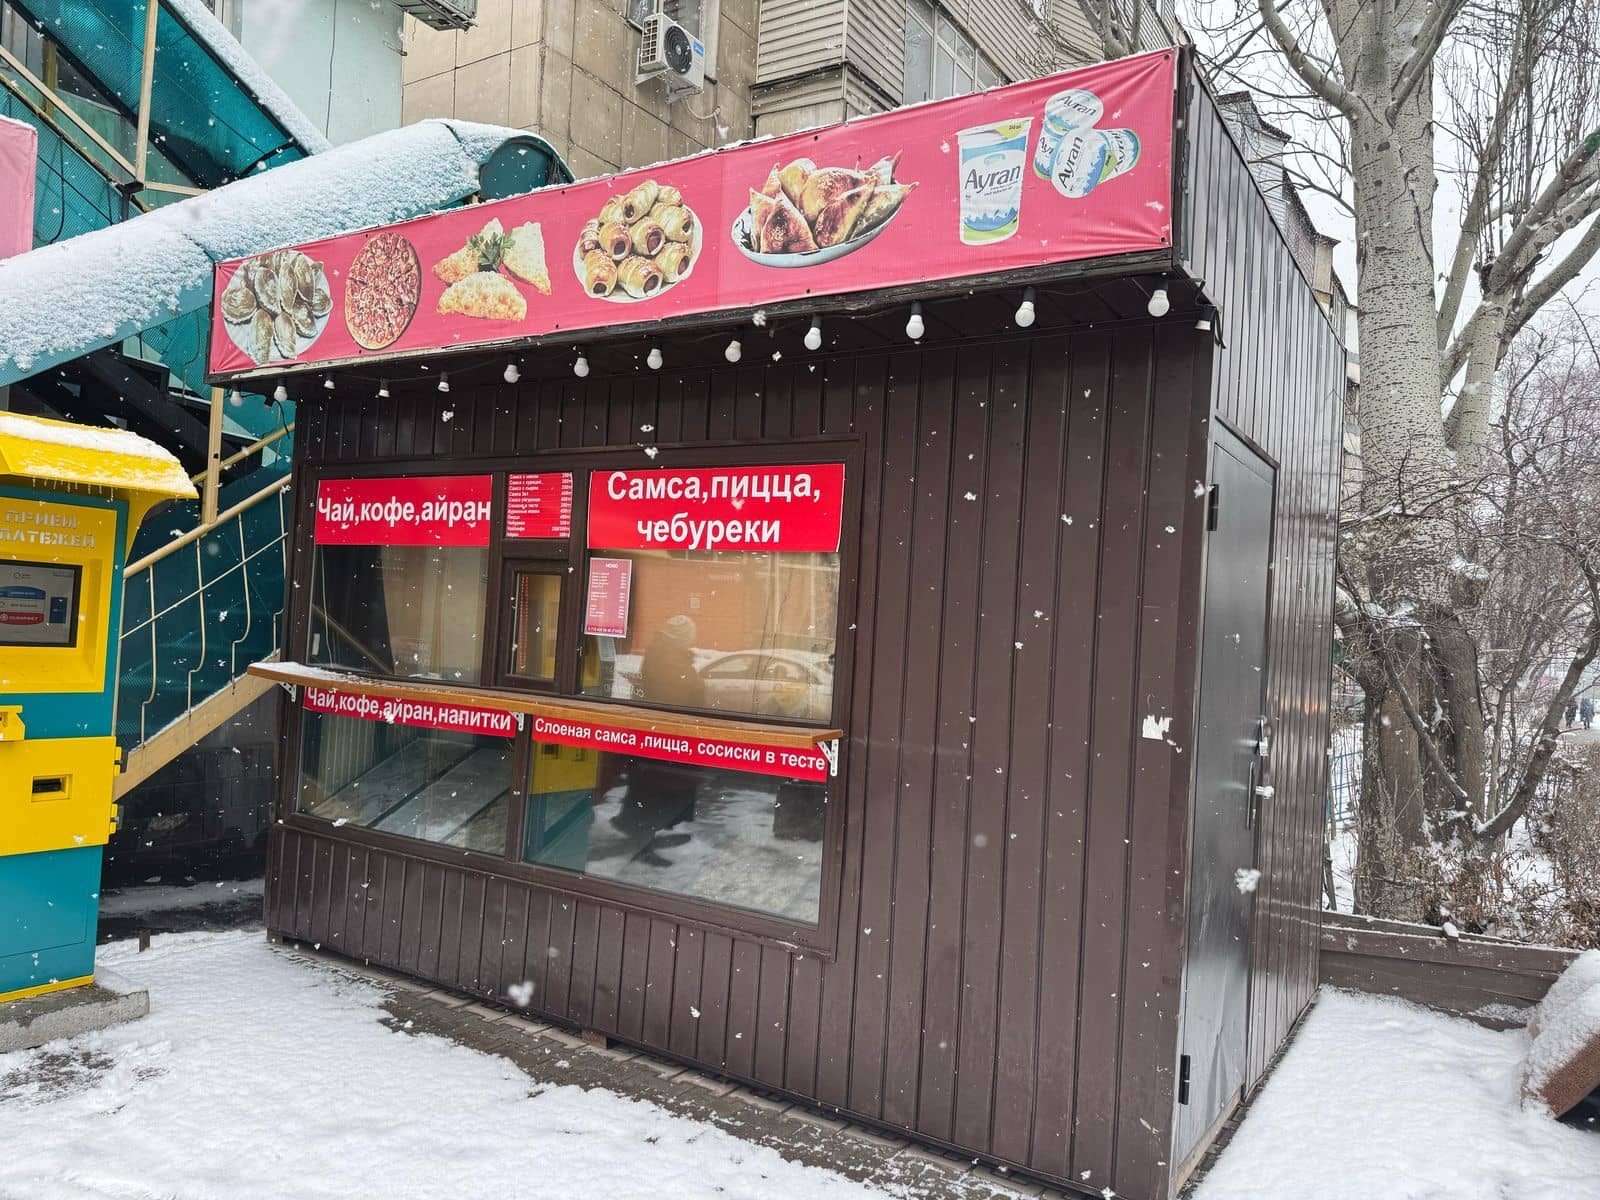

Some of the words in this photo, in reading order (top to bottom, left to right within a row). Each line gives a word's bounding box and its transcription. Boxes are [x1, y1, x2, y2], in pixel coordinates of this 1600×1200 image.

[1057, 96, 1097, 116] Ayran
[964, 165, 1021, 194] Ayran
[1058, 136, 1083, 189] Ayran
[607, 471, 821, 503] Самса,пицца,
[317, 494, 492, 528] Чай,кофе,айран
[637, 512, 781, 550] чебуреки
[302, 686, 511, 731] Чай,кофе,айран,напитки
[535, 718, 592, 739] Слоеная
[594, 729, 637, 746] самса
[639, 735, 693, 756] ,пицца,
[697, 742, 761, 762] сосиски
[765, 751, 776, 764] в
[779, 752, 826, 771] тесте
